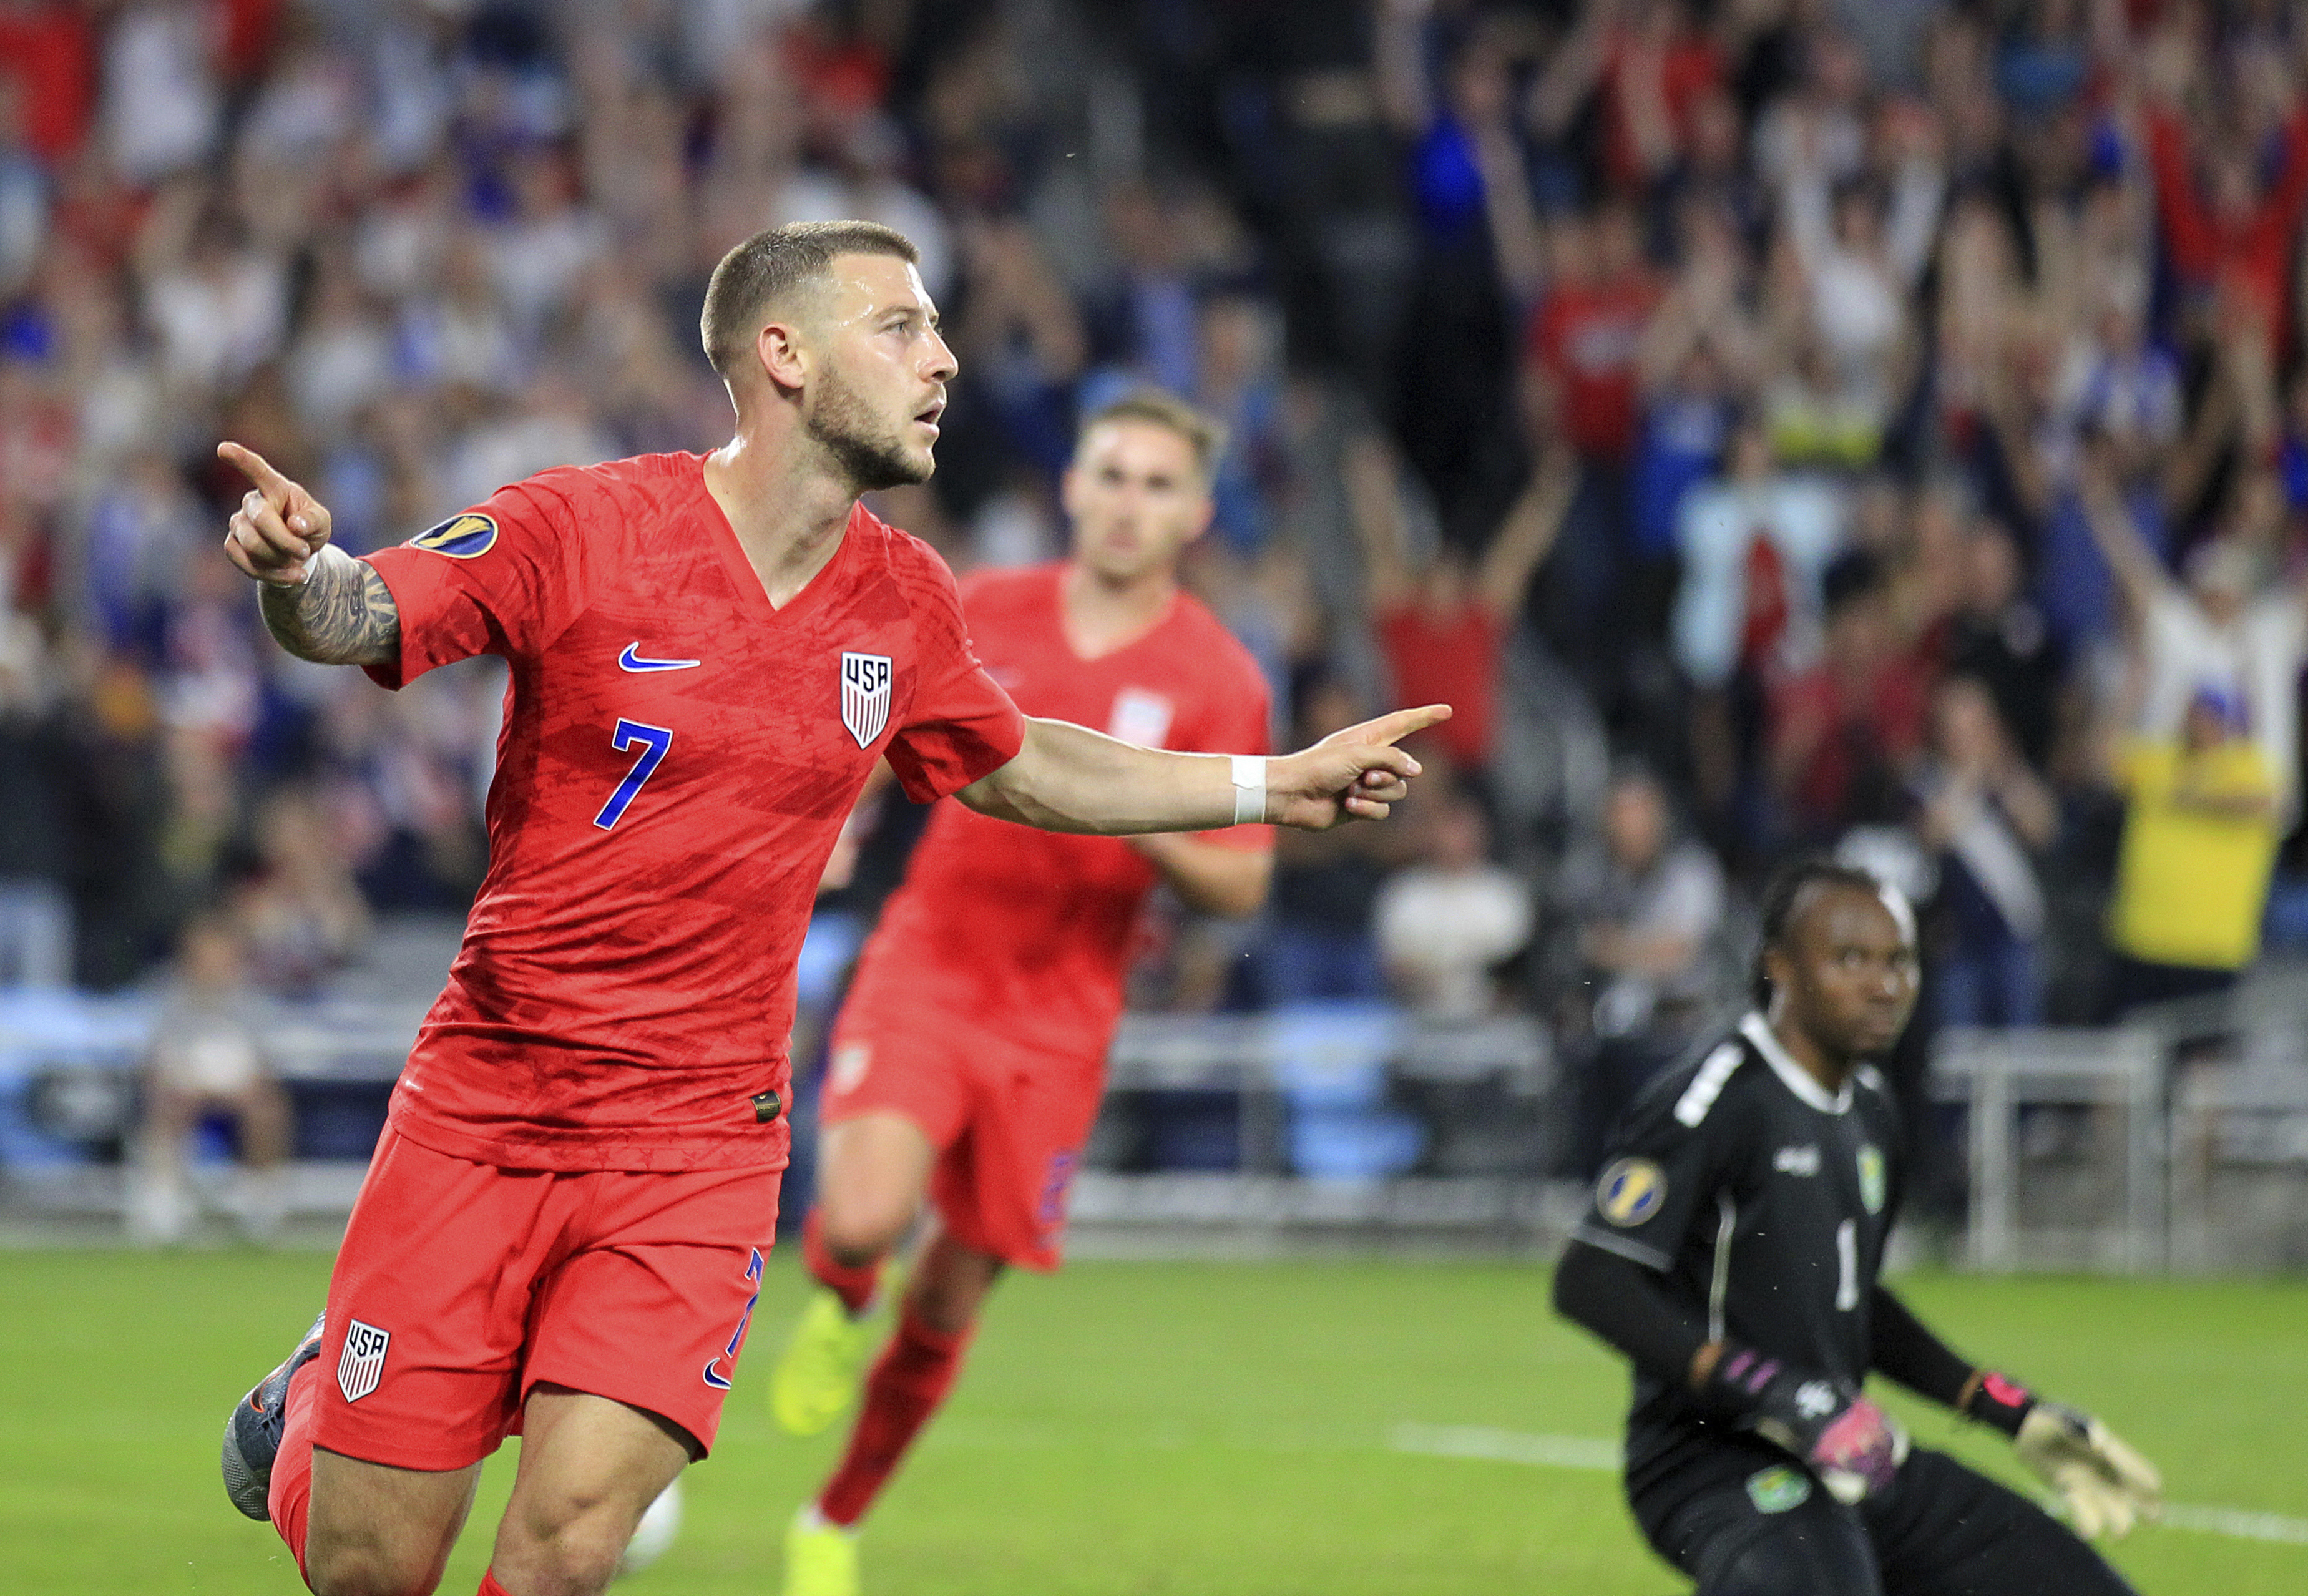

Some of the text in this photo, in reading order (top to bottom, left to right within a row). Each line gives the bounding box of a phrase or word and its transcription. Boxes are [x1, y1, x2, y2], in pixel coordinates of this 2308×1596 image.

[847, 658, 888, 693] USA
[594, 718, 673, 830] 7
[726, 1247, 764, 1358] 7
[1836, 1218, 1859, 1311] 1
[350, 1324, 385, 1357] USA
